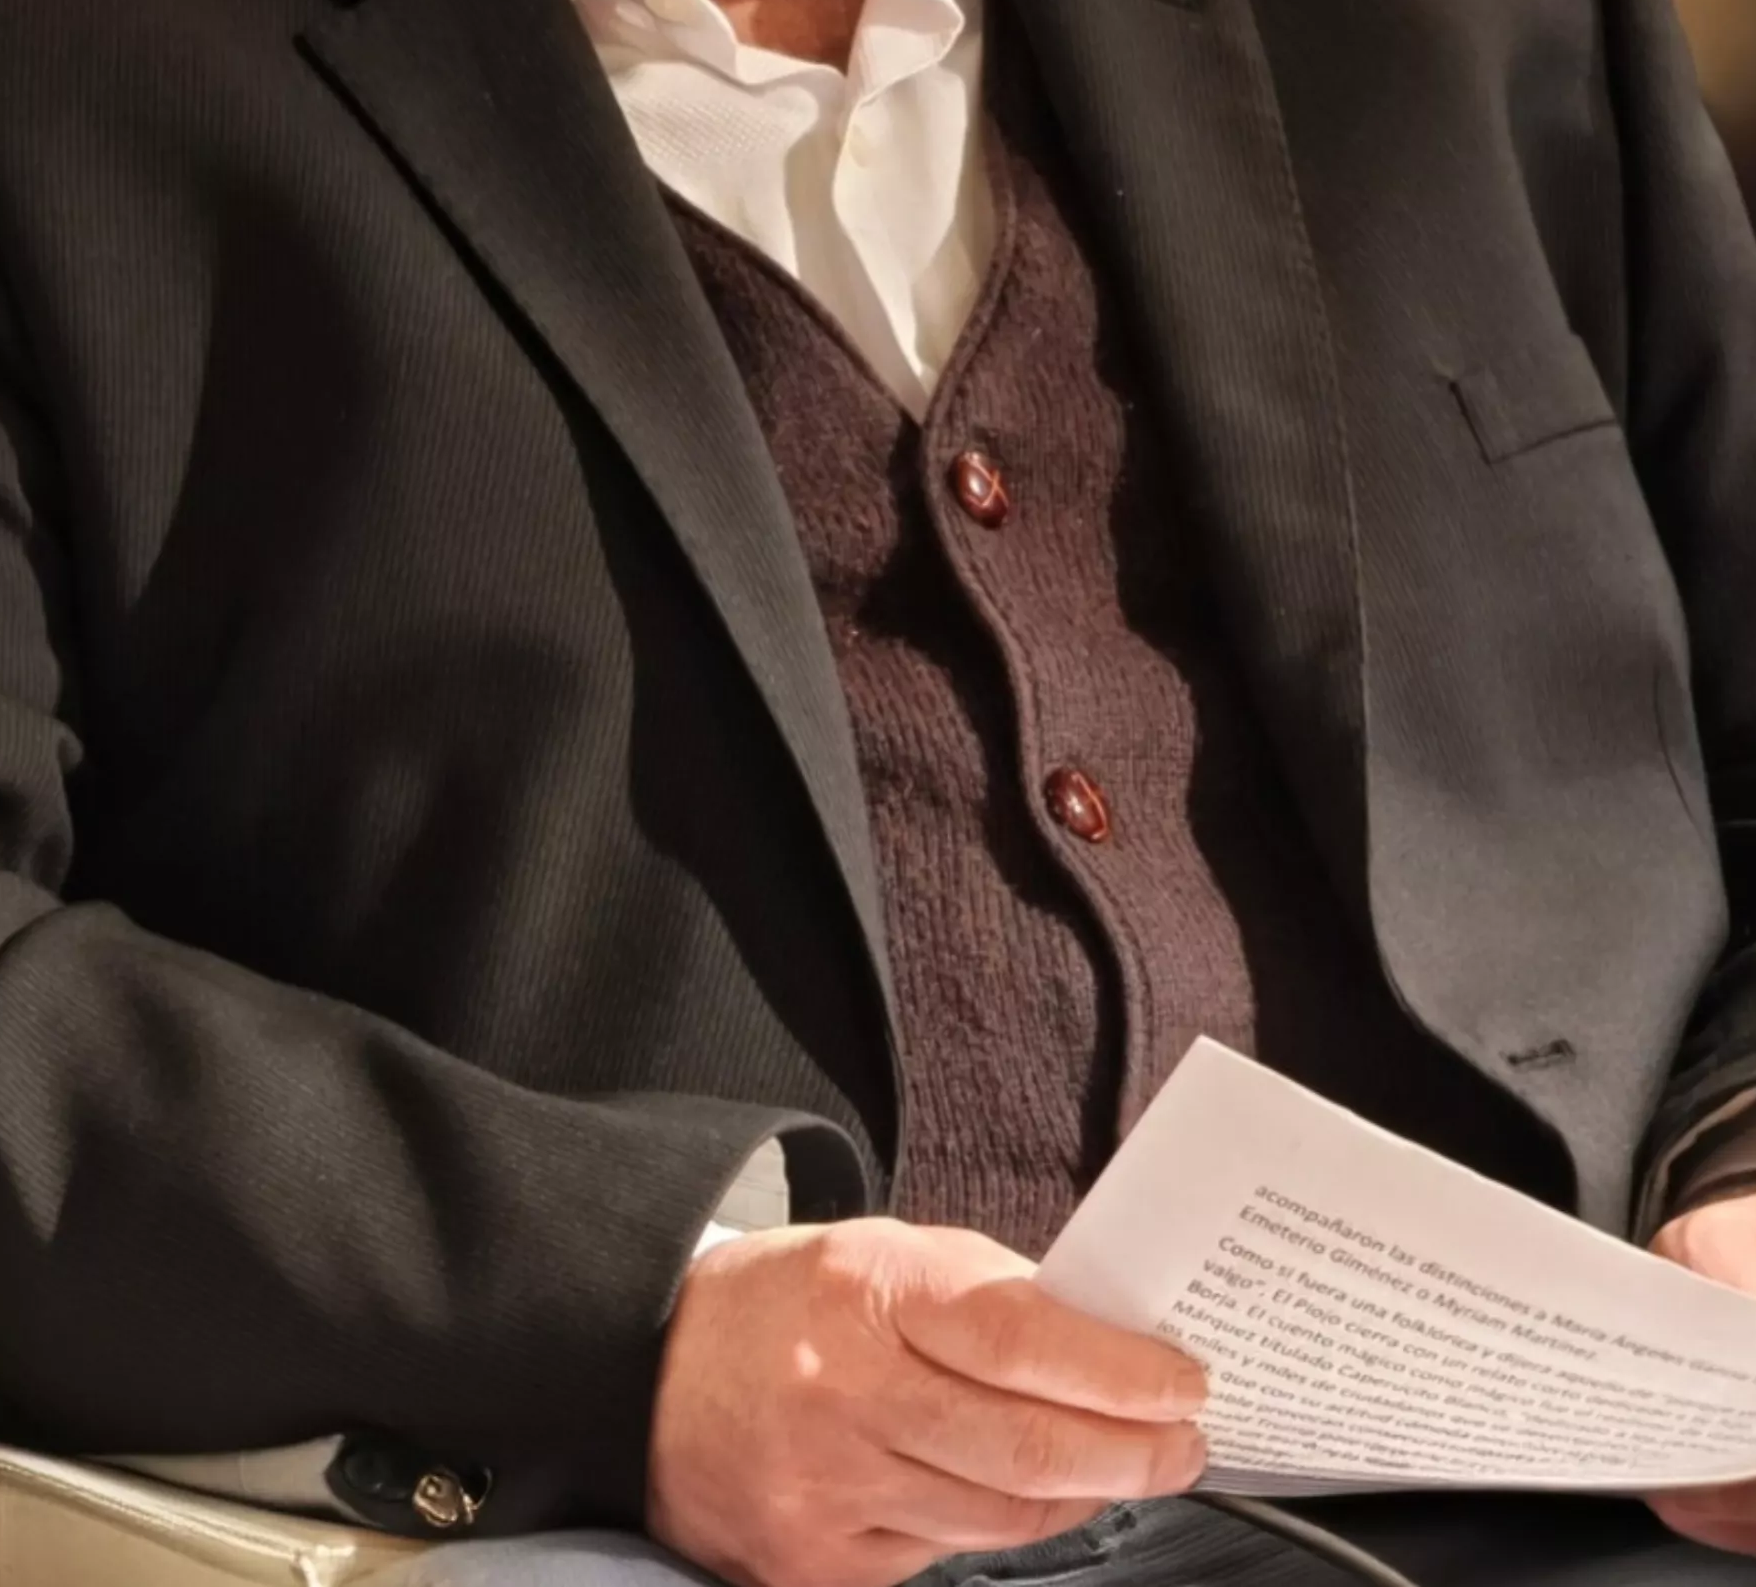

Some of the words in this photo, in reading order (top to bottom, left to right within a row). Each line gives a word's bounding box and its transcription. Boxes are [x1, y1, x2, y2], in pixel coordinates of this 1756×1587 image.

[1218, 1235, 1274, 1270] Como
[1277, 1264, 1295, 1278] si
[1296, 1271, 1347, 1303] fuera
[1350, 1298, 1387, 1320] una
[1390, 1311, 1478, 1352] folklórica
[1481, 1348, 1495, 1360] y
[1239, 1204, 1326, 1255] Emeterio
[1329, 1247, 1414, 1295] Giménez
[1416, 1288, 1430, 1301] o
[1433, 1294, 1508, 1330] Myriam
[1254, 1185, 1386, 1252] acompañaron
[1388, 1245, 1417, 1266] las
[1419, 1262, 1531, 1315] distinciones
[1534, 1311, 1548, 1322] a
[1156, 1318, 1183, 1340] los
[1188, 1332, 1238, 1360] miles
[1241, 1356, 1255, 1369] y
[1257, 1362, 1307, 1387] miles
[1310, 1377, 1336, 1393] de
[1172, 1299, 1256, 1342] Márquez
[1259, 1334, 1334, 1372] titulado
[1246, 1304, 1266, 1320] El
[1267, 1314, 1335, 1348] cuento
[1336, 1341, 1406, 1375] mágico
[1409, 1368, 1464, 1389] como
[1271, 1288, 1293, 1305] El
[1293, 1297, 1342, 1327] Piojo
[1344, 1321, 1400, 1348] cierra
[1402, 1343, 1438, 1362] con
[1441, 1355, 1468, 1371] un
[1470, 1365, 1527, 1388] relato
[1219, 1371, 1257, 1390] que
[1260, 1384, 1295, 1401] con
[1299, 1395, 1323, 1408] su
